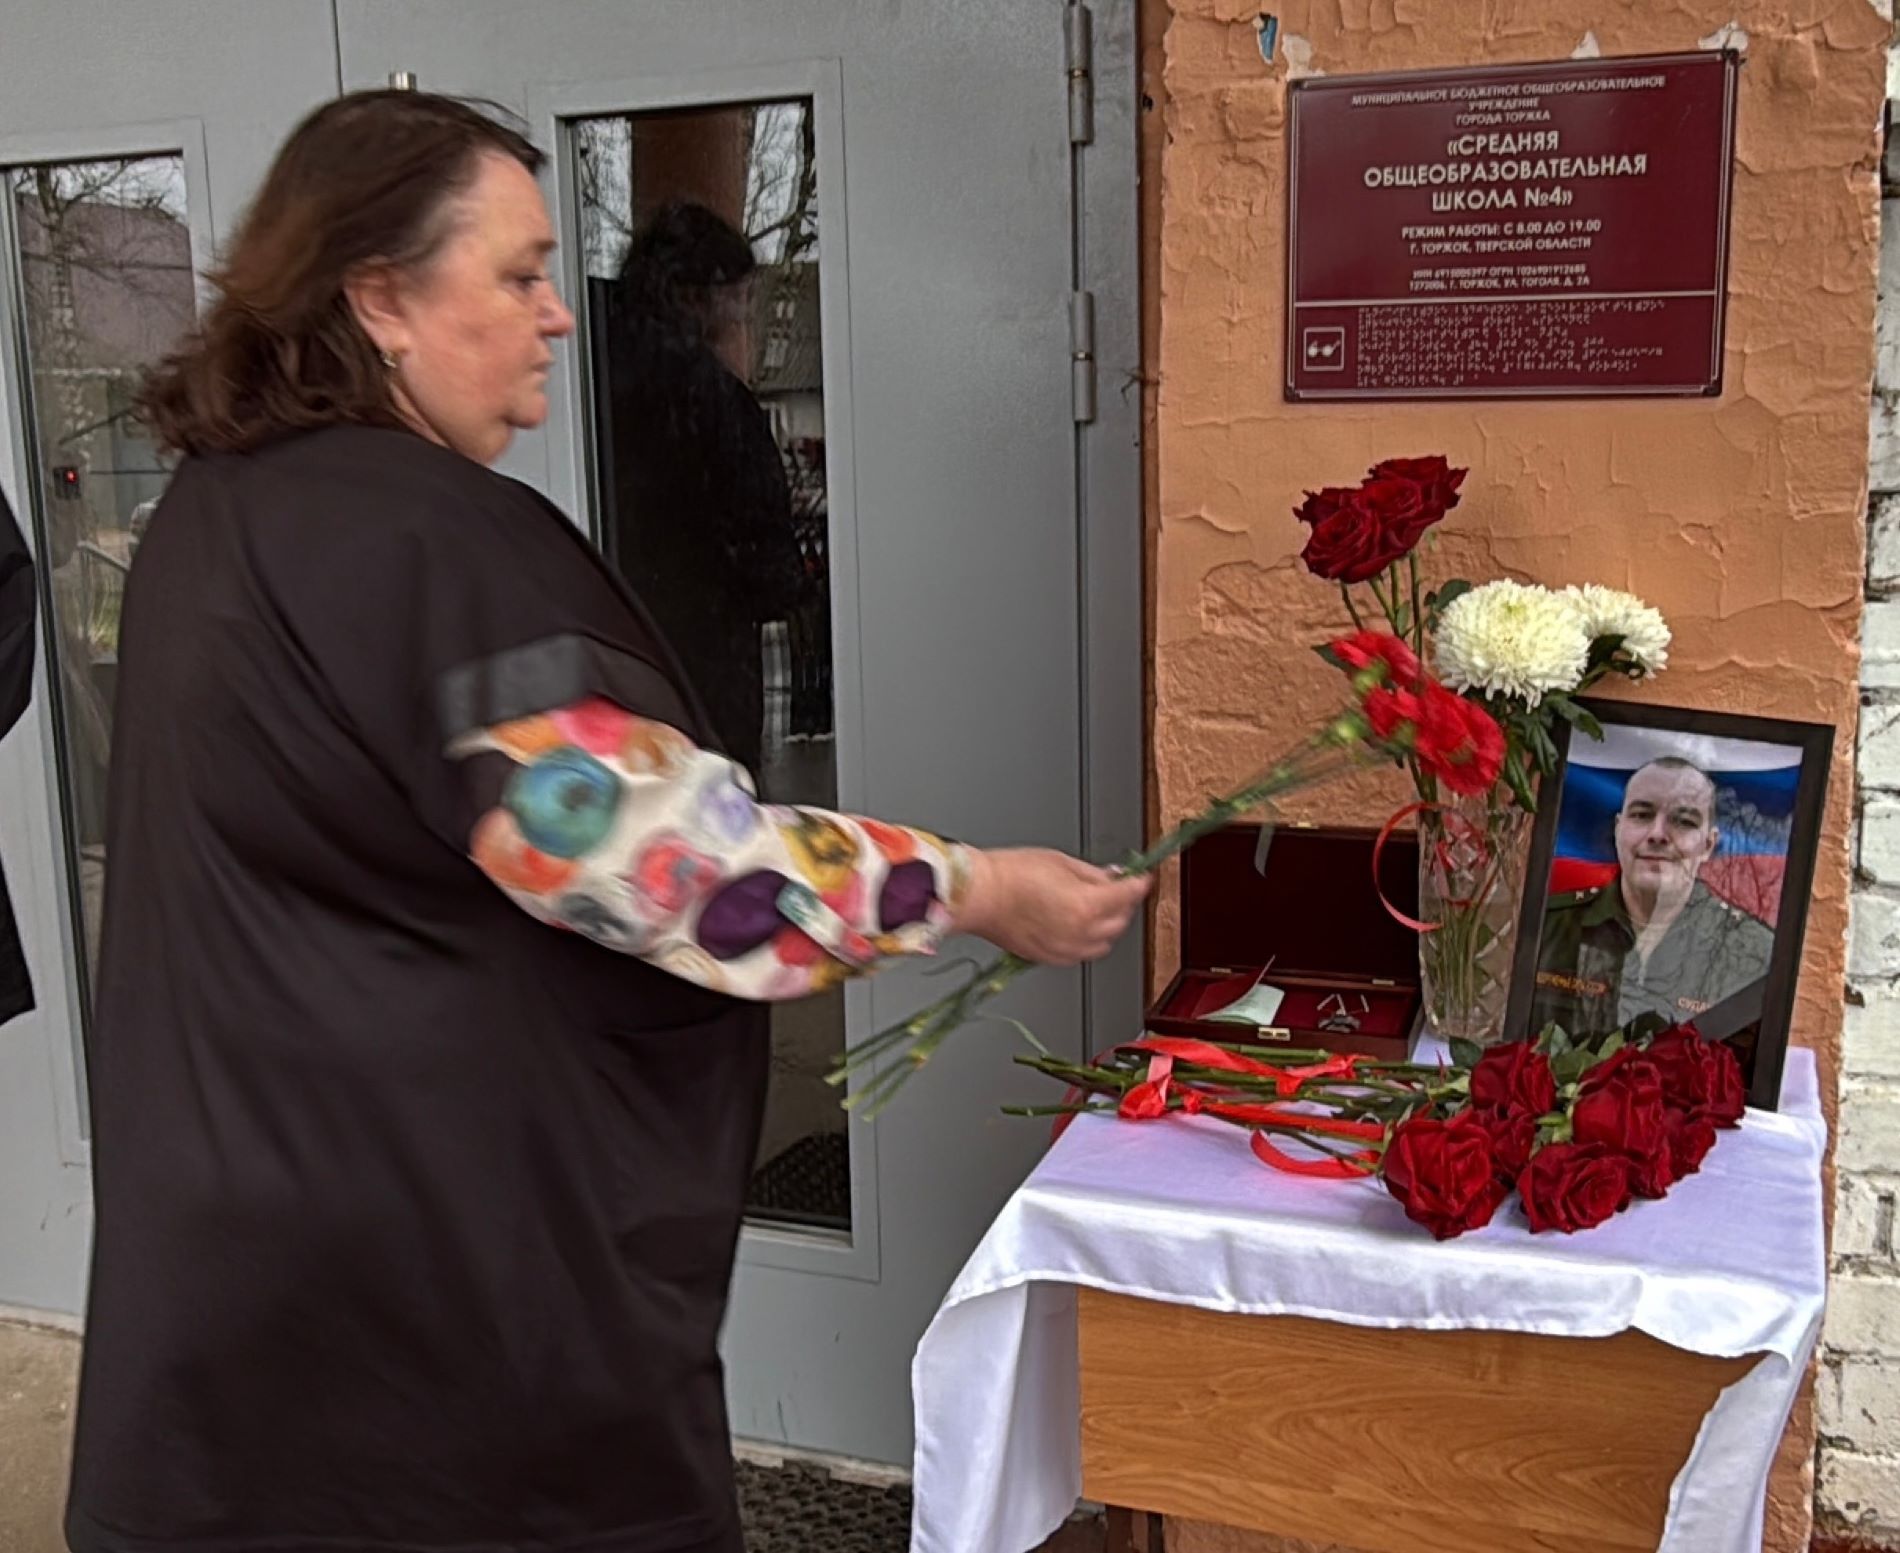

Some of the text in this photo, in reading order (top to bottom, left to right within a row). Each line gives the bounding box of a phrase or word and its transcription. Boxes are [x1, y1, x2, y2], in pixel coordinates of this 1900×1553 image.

[1351, 75, 1666, 106] МУНИЦИПАЛЬНОЕ БЮДЖЕТНОЕ ОБЩЕОБРАЗОВАТЕЛЬНОЕ
[1468, 97, 1539, 112] УЧРЕЖДЕНИЕ
[1455, 110, 1551, 126] ГОРОДА ТОРЖКА
[1447, 130, 1560, 156] «СРЕДНЯЯ
[1364, 153, 1648, 189] ОБЩЕОБРАЗОВАТЕЛЬНАЯ
[1432, 186, 1573, 212] ШКОЛА №4»
[1401, 218, 1602, 240] РЕЖИМ РАБОТЫ: С 8.00 ДО 19.00
[1409, 236, 1592, 256] Г. ТОРЖОК, ТВЕРСКОЙ ОБЛАСТИ
